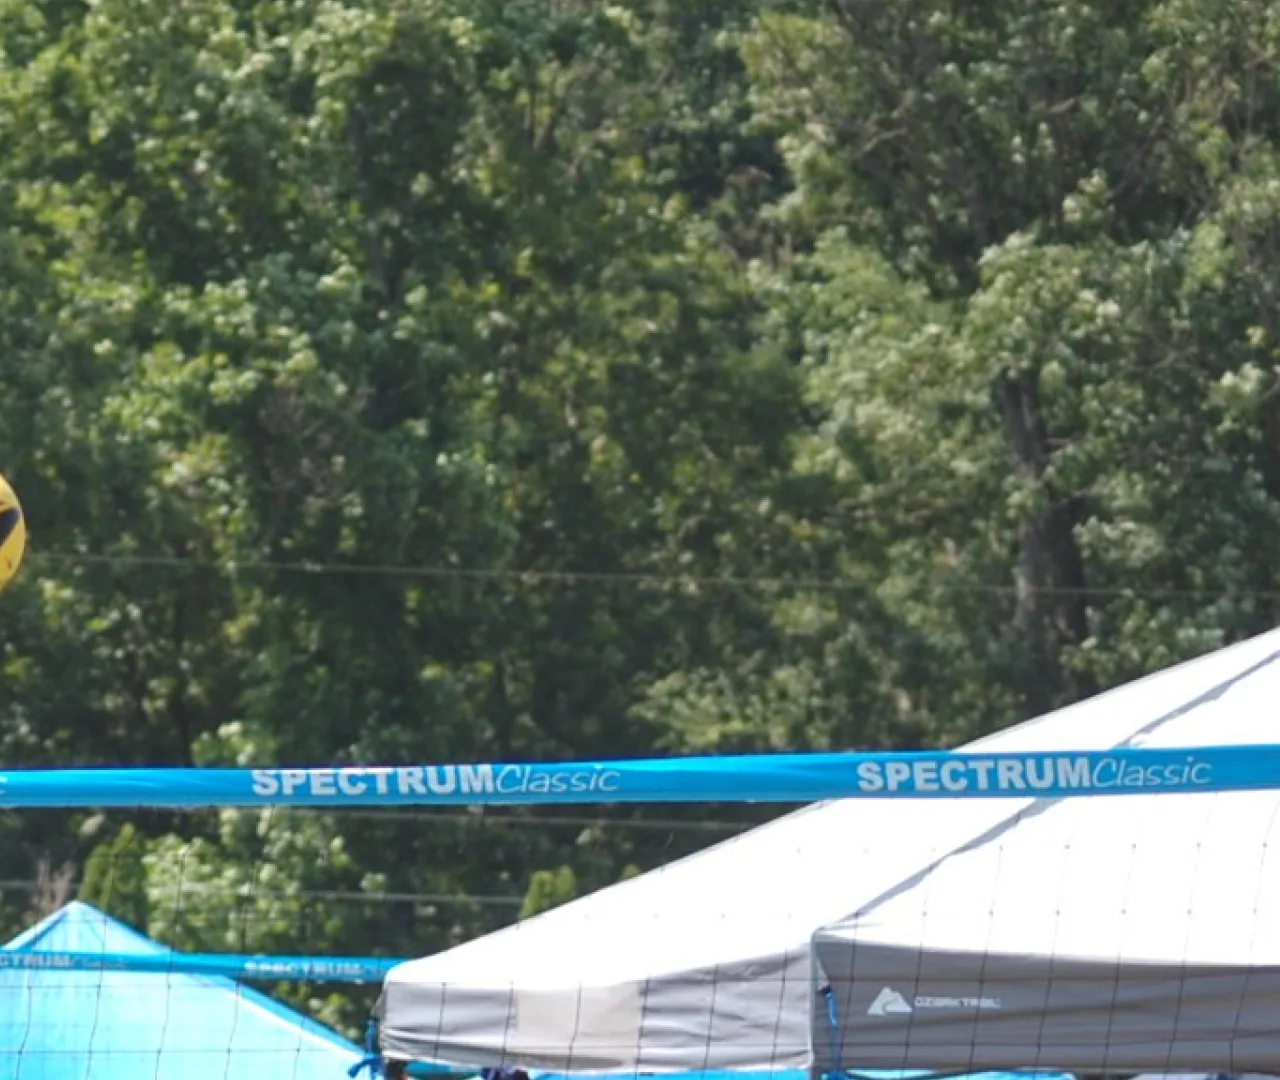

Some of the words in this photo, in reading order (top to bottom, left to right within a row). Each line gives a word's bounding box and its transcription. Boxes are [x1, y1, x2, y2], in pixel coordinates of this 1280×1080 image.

[251, 764, 496, 796] SPECTRUM
[497, 762, 621, 794] Classic
[856, 755, 1091, 792] SPECTRUM
[1092, 754, 1212, 789] Classic
